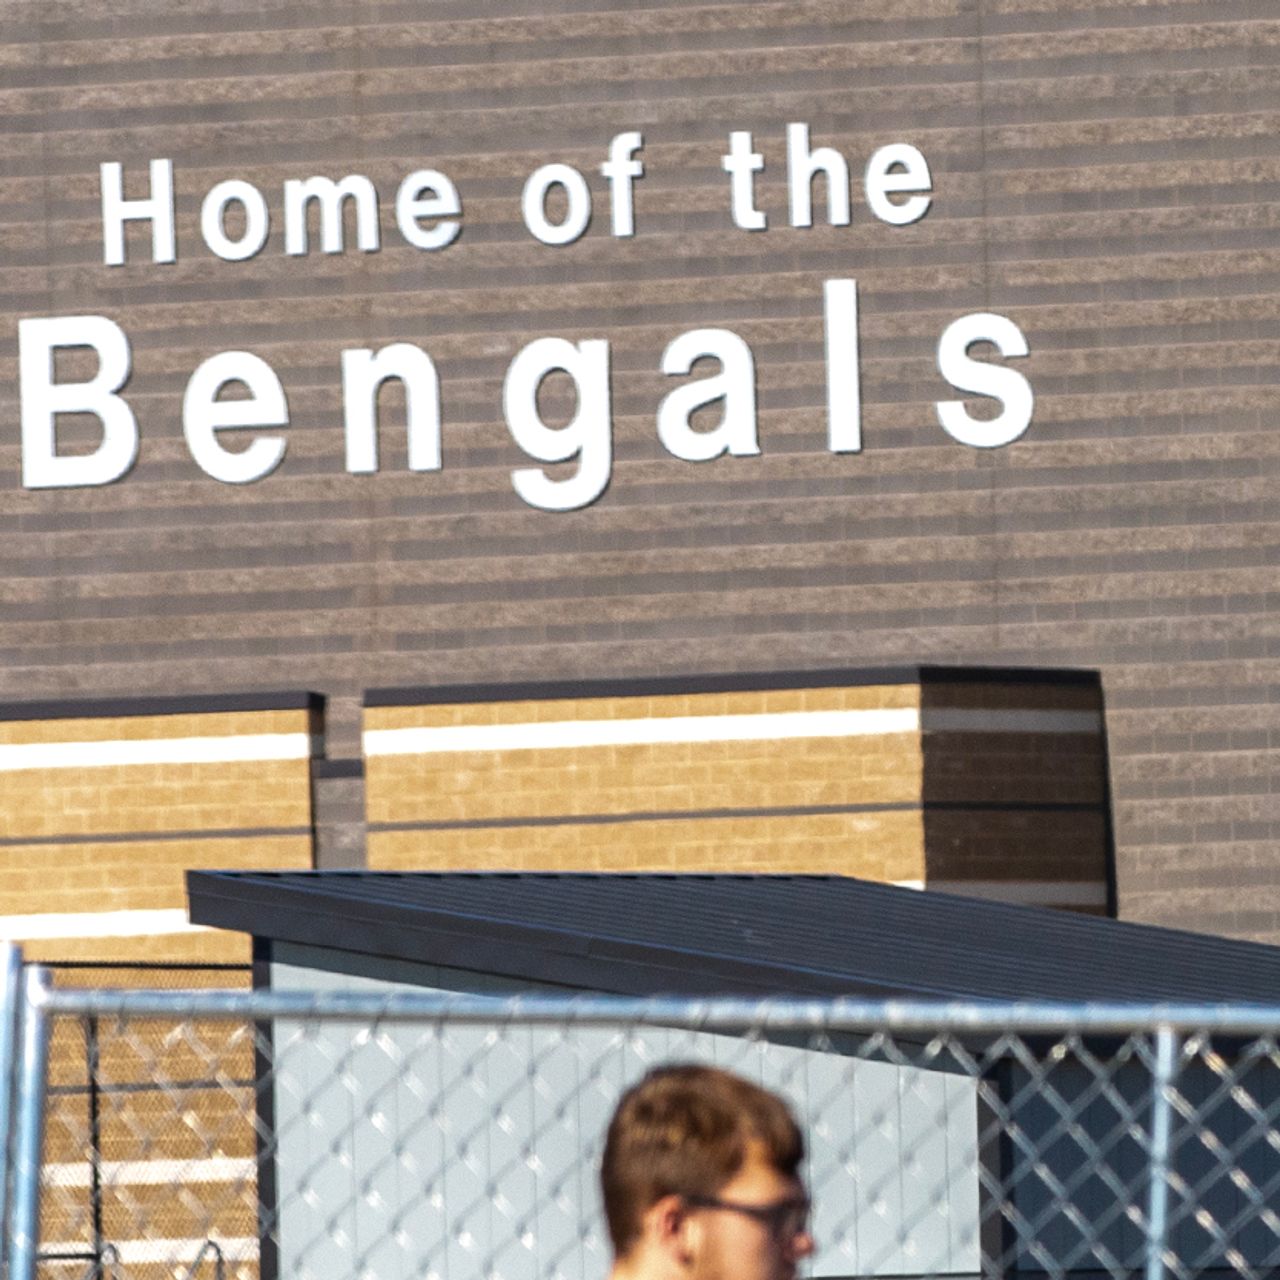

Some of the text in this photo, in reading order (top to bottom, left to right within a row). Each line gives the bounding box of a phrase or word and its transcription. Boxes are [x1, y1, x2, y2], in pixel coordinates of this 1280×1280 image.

[99, 123, 931, 265] Home of the
[18, 279, 1035, 510] Bengals
